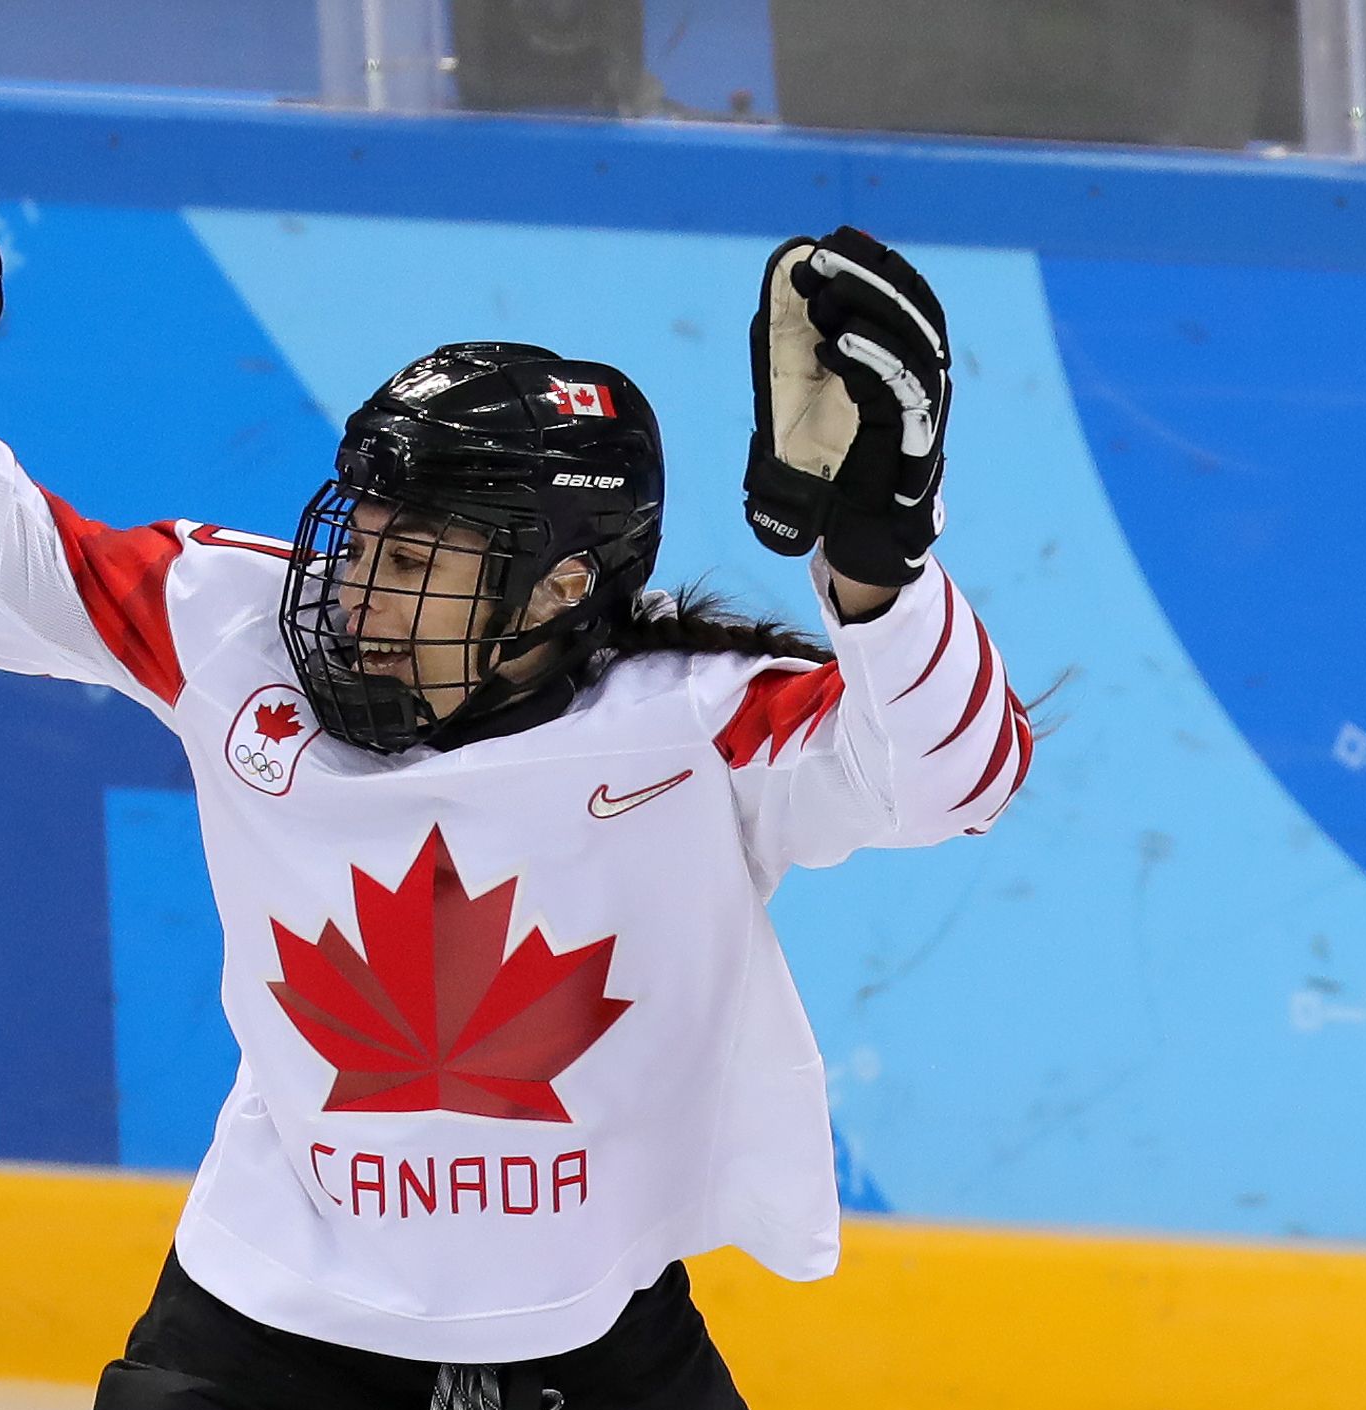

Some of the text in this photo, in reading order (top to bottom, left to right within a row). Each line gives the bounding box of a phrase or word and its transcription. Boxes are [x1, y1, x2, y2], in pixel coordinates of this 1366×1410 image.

[551, 472, 626, 490] BAUER
[752, 509, 800, 540] BAUER
[310, 1141, 589, 1219] CANADA
